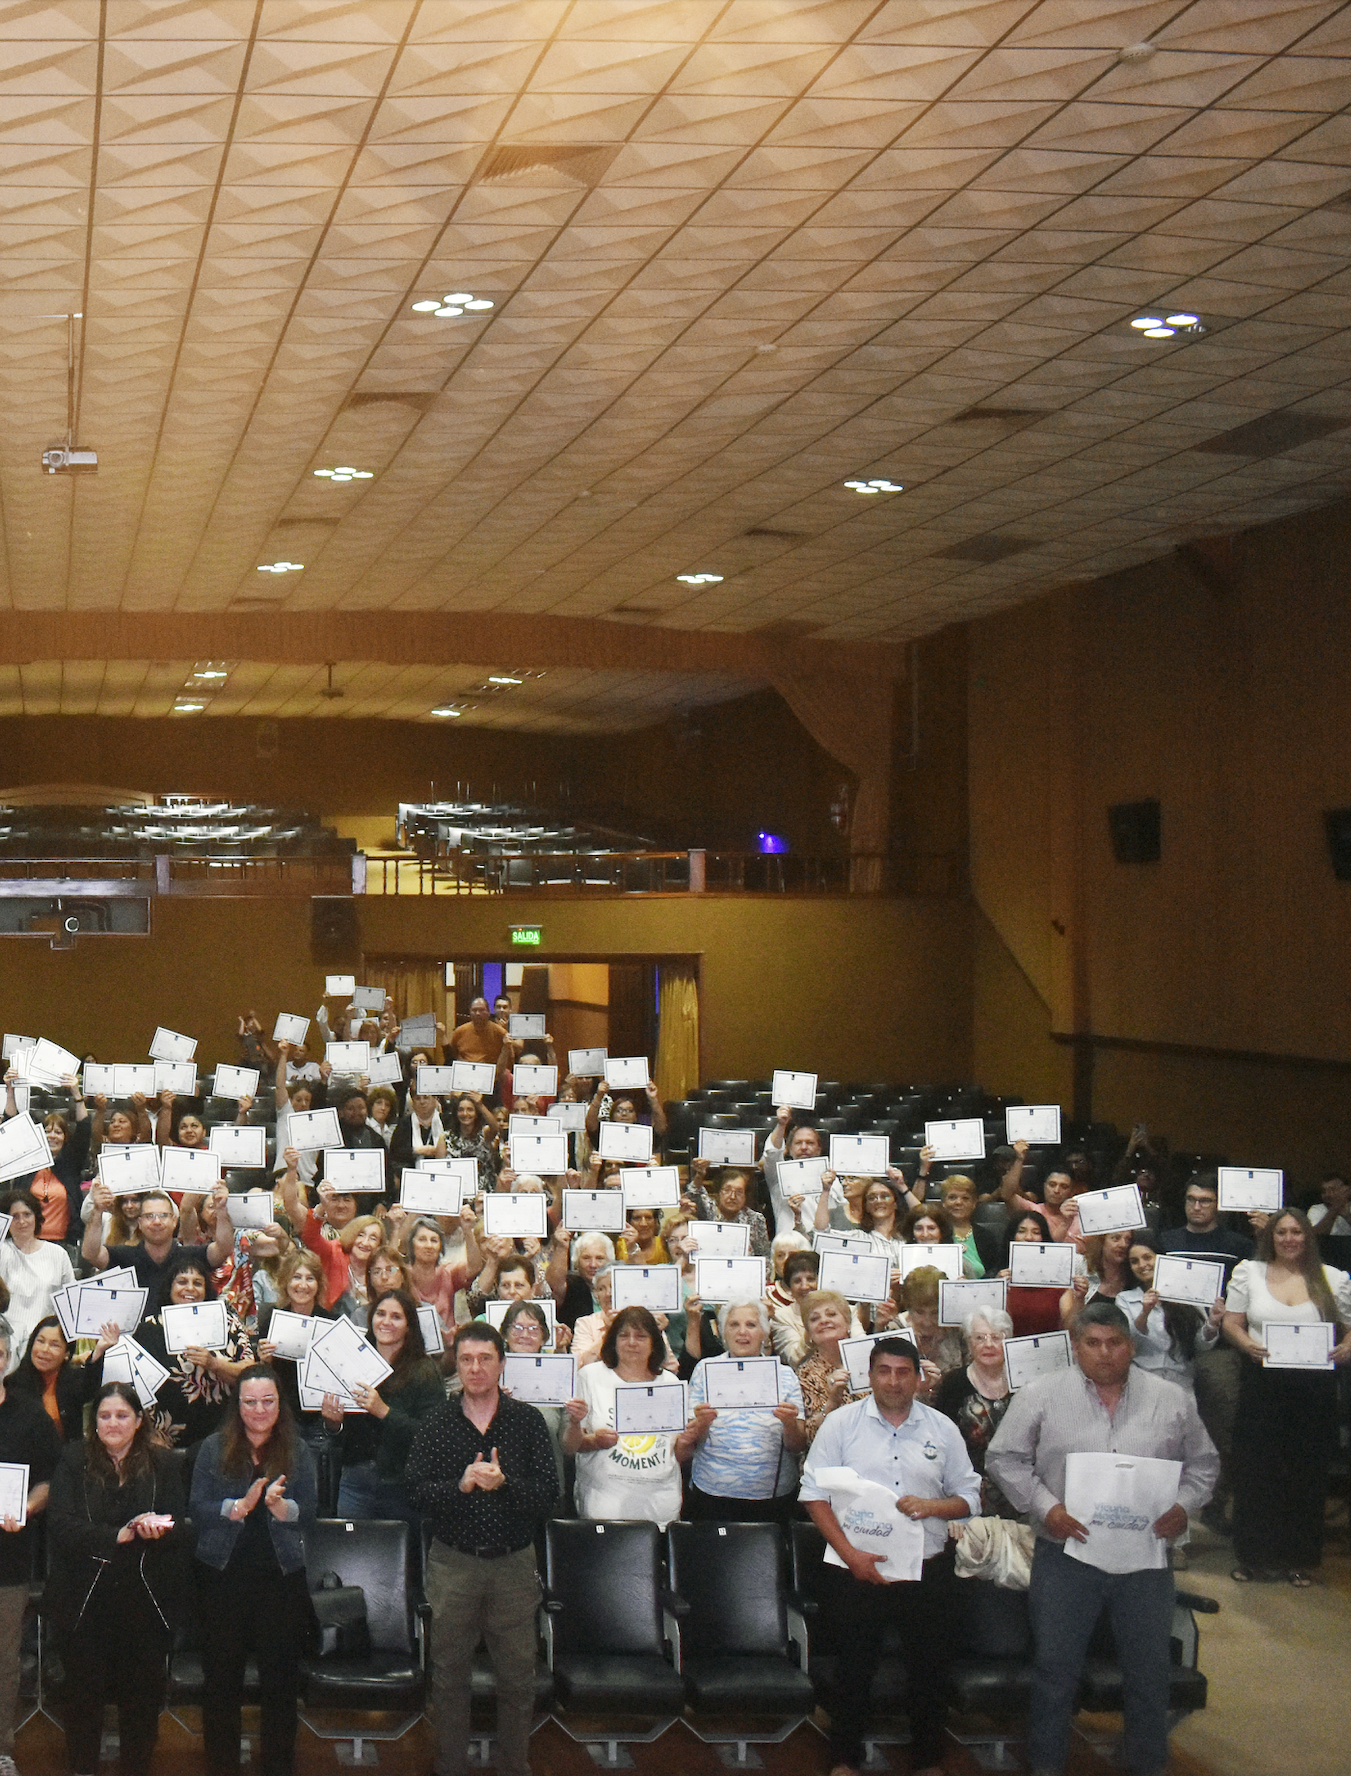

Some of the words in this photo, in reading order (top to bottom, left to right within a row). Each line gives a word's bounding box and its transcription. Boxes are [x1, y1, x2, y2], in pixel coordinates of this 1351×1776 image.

[512, 931, 539, 941] SALIDA
[608, 1448, 666, 1470] MOMENT!
[854, 1525, 894, 1537] ciudad
